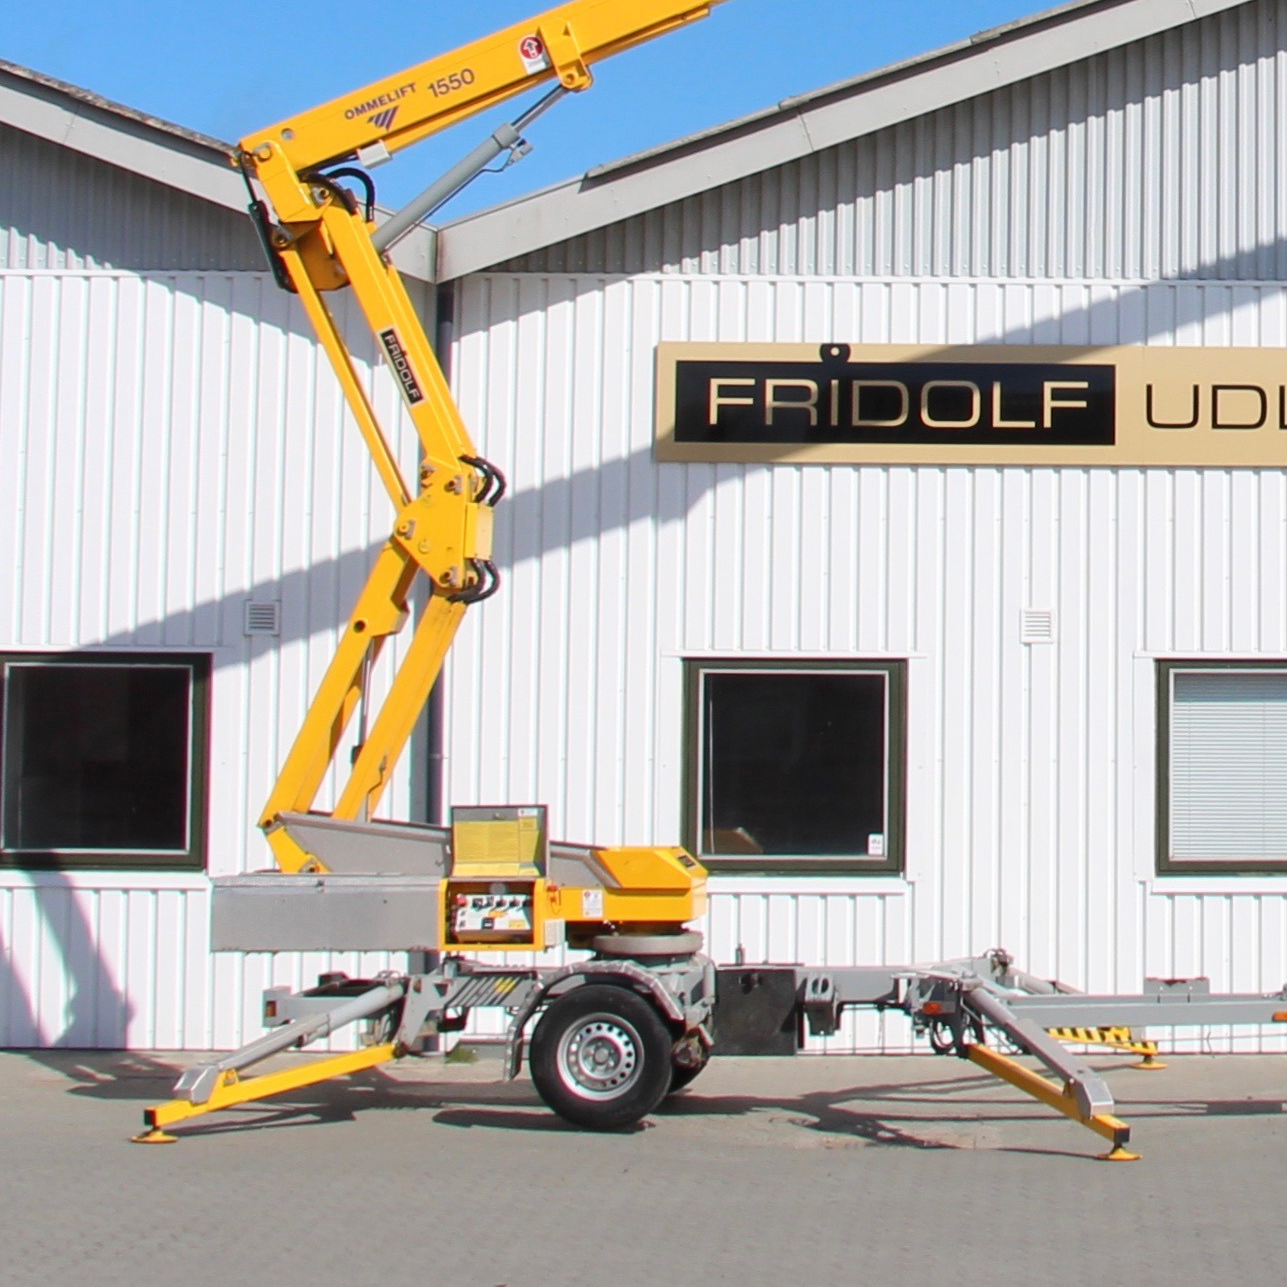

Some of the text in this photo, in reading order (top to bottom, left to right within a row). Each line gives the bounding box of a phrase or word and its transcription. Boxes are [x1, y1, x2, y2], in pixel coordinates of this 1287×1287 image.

[344, 68, 475, 121] OMMELIFT 1550
[384, 334, 420, 399] FRIDOLF
[707, 377, 1090, 430] FRIDOLF
